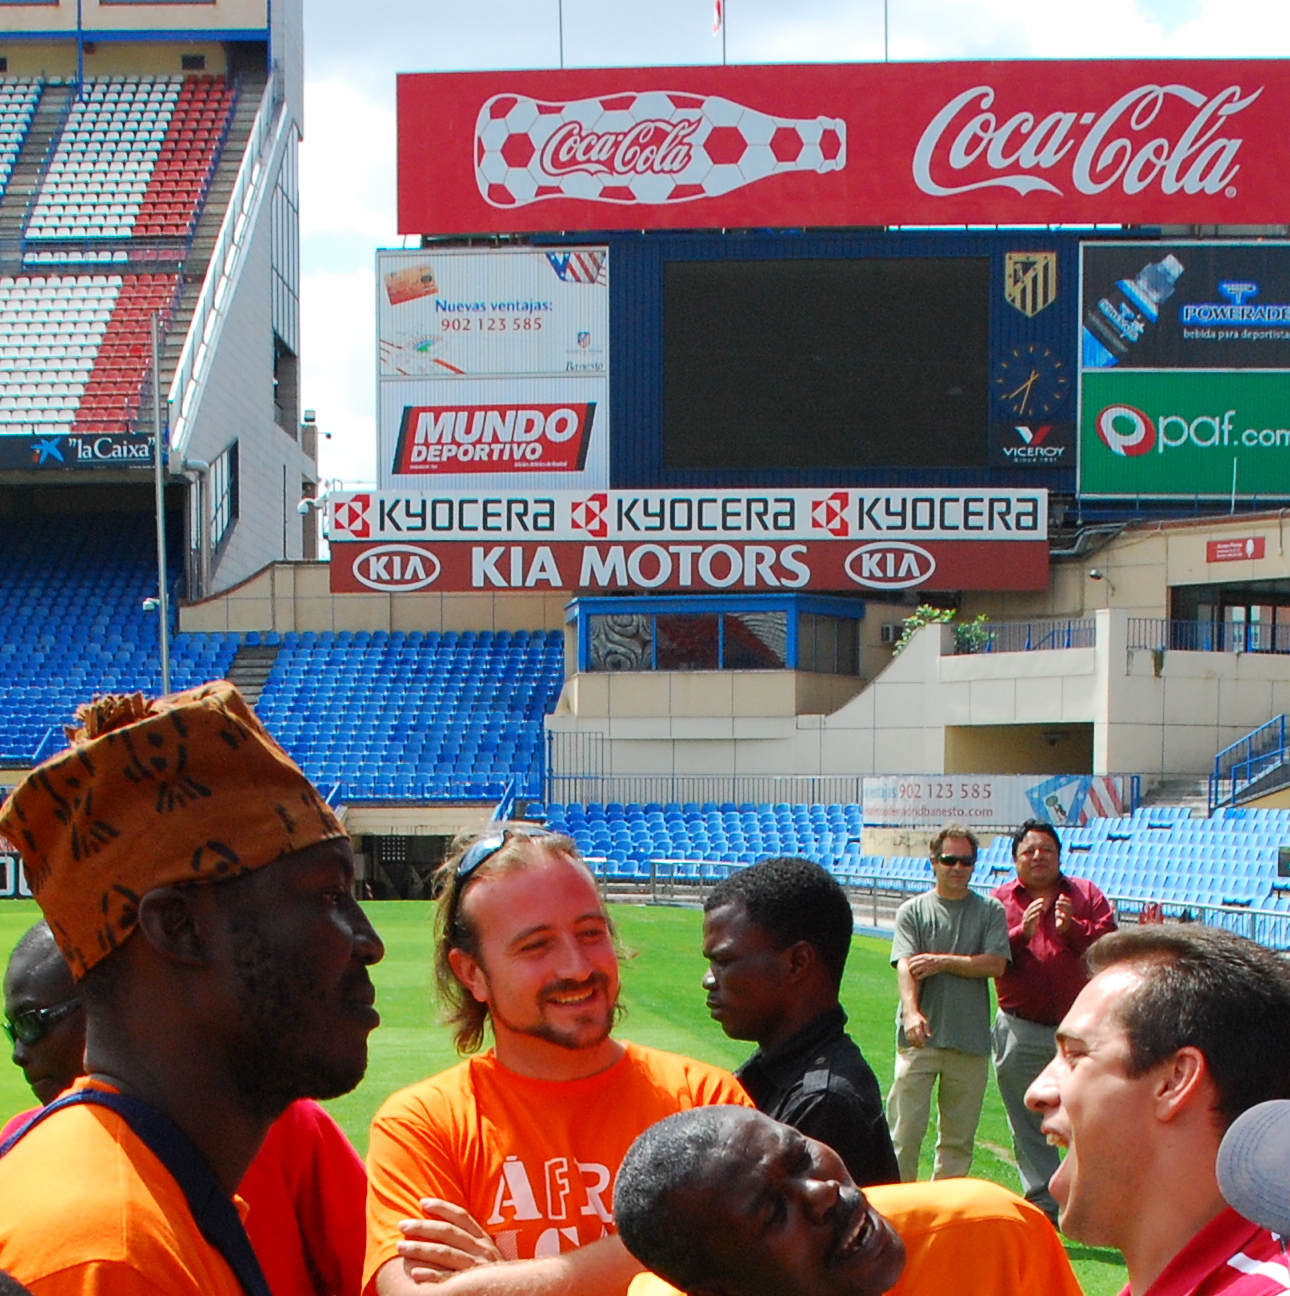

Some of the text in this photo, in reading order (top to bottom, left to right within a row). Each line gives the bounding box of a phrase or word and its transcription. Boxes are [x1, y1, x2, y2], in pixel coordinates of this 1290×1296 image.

[540, 117, 702, 177] Coca-Cola
[913, 84, 1265, 196] Coca-Cola
[435, 299, 553, 315] Nuevas ventajas:
[441, 317, 542, 331] 902 123 585
[1184, 328, 1216, 339] bebida
[1218, 330, 1239, 340] para
[414, 408, 579, 443] MUNDO
[410, 442, 543, 462] DEPORTIVO
[1002, 446, 1065, 457] VICEROY
[378, 496, 555, 532] KYOCERA
[616, 496, 796, 532] KYOCERA
[856, 495, 1038, 532] KYOCERA
[369, 555, 427, 580] KIA
[471, 543, 811, 590] KIA MOTORS
[860, 553, 921, 579] KIA
[899, 783, 922, 799] 902
[928, 783, 954, 799] 123
[960, 783, 992, 799] 585
